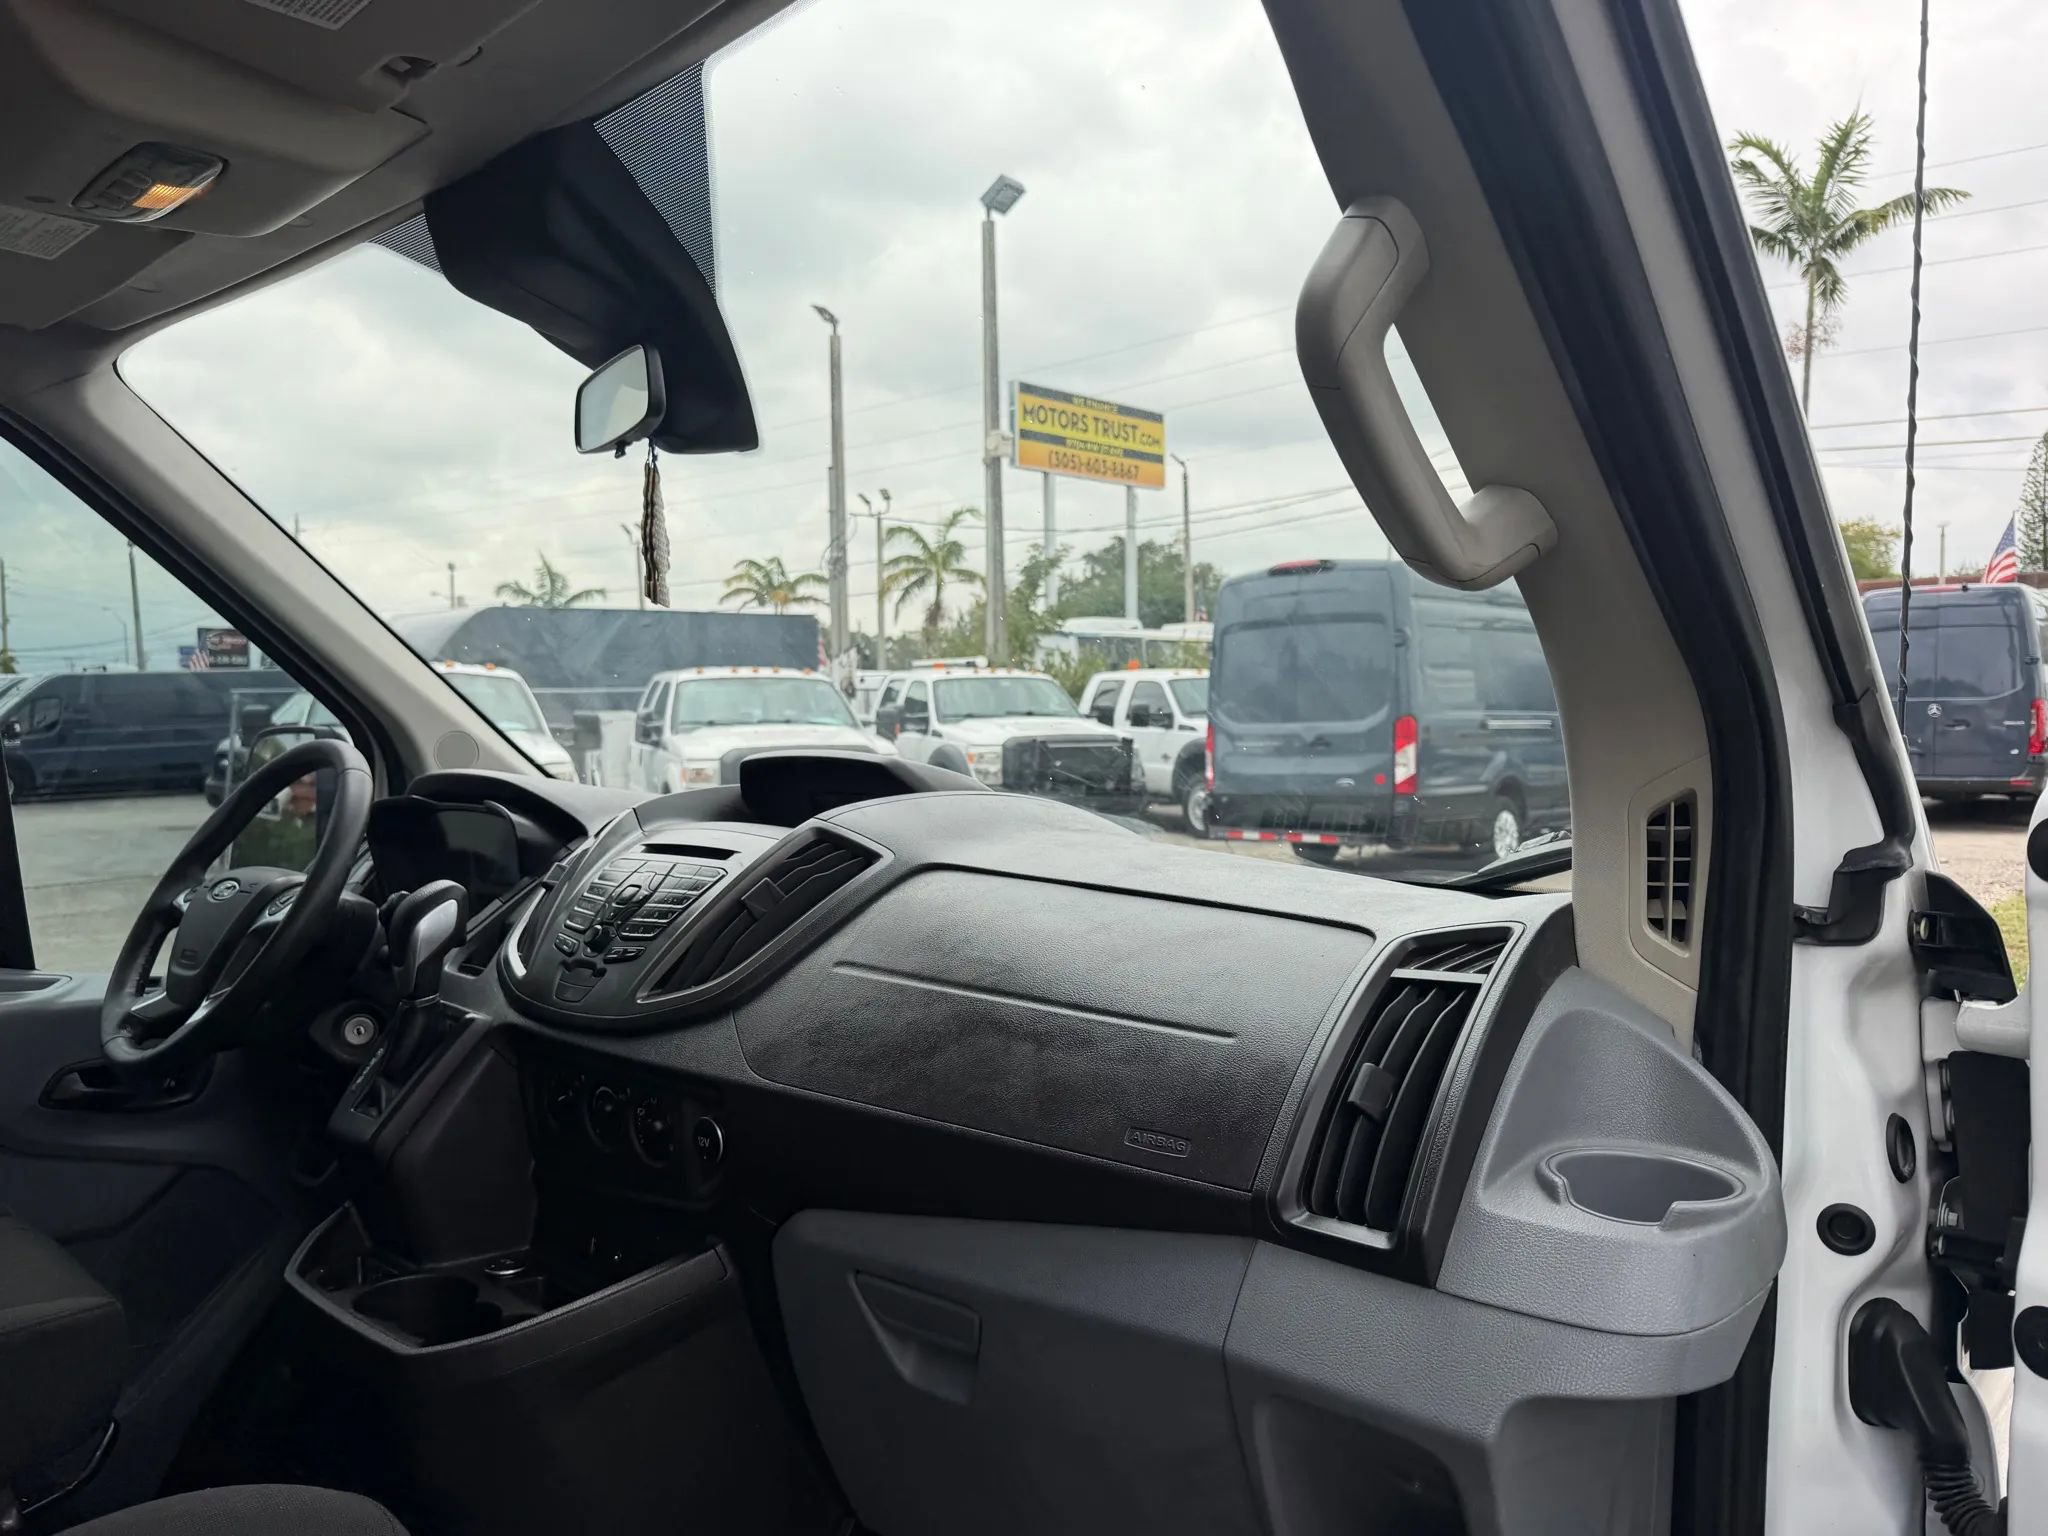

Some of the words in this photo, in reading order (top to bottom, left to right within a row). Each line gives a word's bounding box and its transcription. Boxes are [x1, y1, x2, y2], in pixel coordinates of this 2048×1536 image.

[1022, 404, 1090, 434] MOTORS
[697, 1136, 710, 1148] 12V
[1130, 1131, 1187, 1151] AIRBAG
